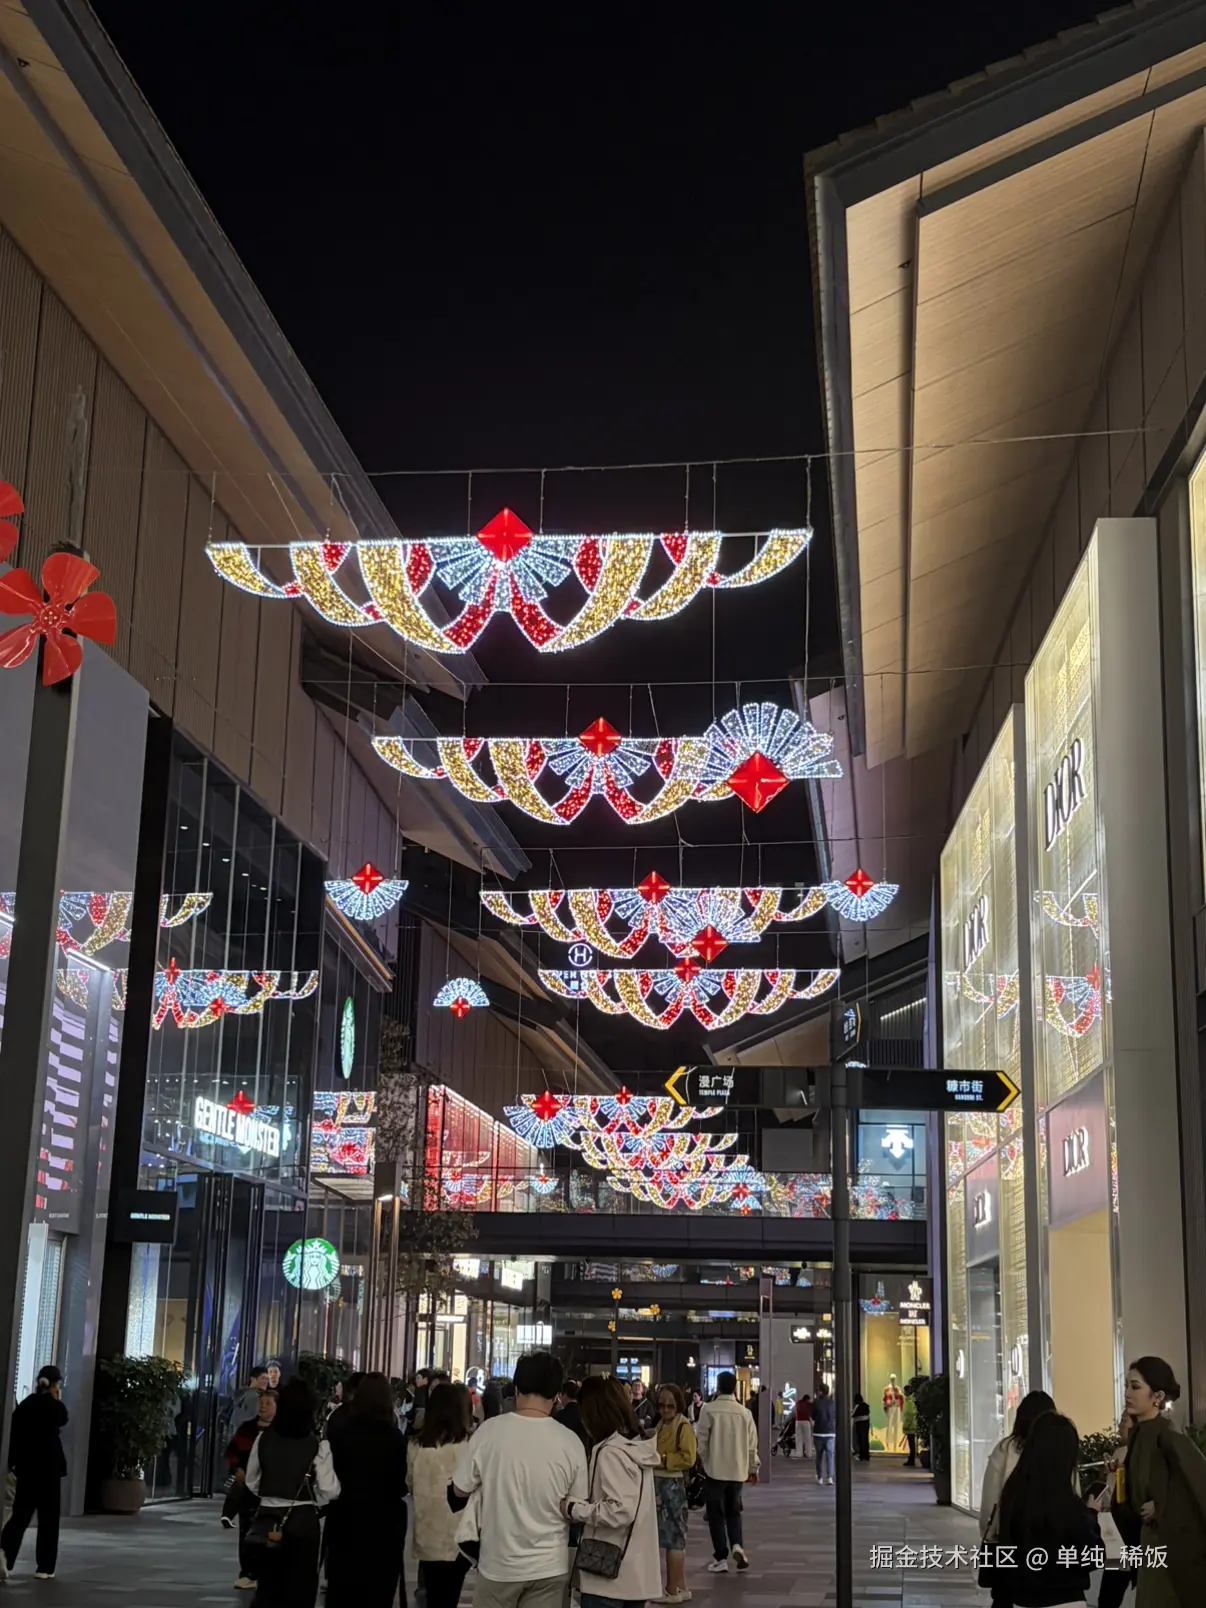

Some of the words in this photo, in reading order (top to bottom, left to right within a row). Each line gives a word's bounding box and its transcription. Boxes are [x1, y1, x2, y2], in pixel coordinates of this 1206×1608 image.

[1044, 738, 1088, 852] DIOR
[962, 894, 990, 973] DIOR
[699, 1075, 734, 1088] 漫广场
[194, 1096, 236, 1141] GENTLE
[235, 1112, 280, 1157] MONSTER
[899, 1302, 930, 1310] MONCLER
